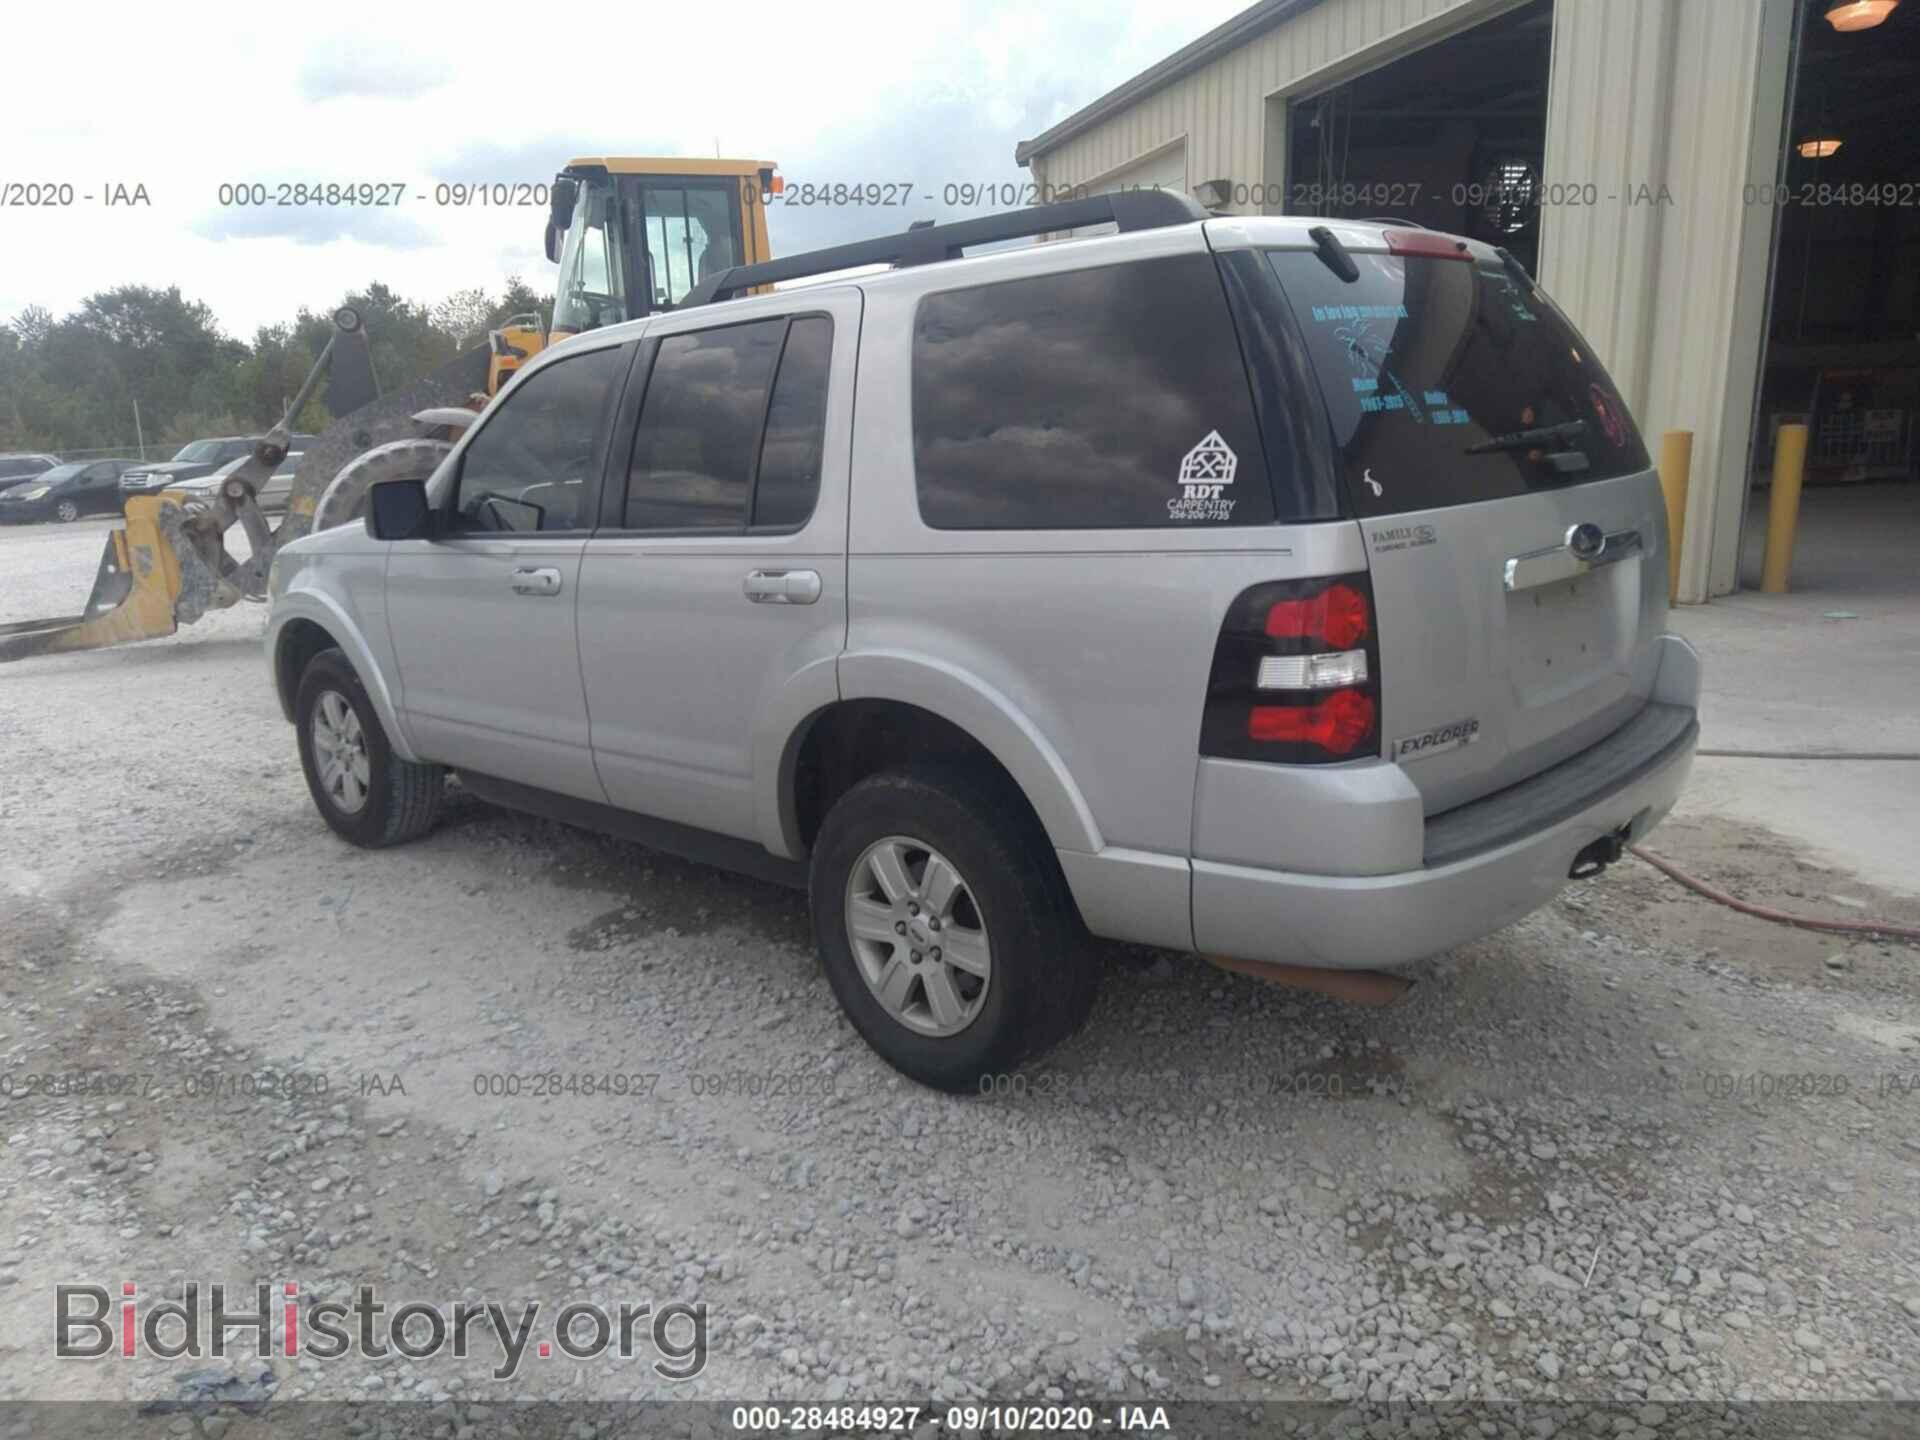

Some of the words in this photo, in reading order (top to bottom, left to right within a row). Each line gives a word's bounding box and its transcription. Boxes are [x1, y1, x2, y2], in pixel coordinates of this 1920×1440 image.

[1183, 484, 1225, 499] RDT
[1167, 498, 1237, 512] CARPENTRY
[1400, 719, 1480, 754] EXPLORER
